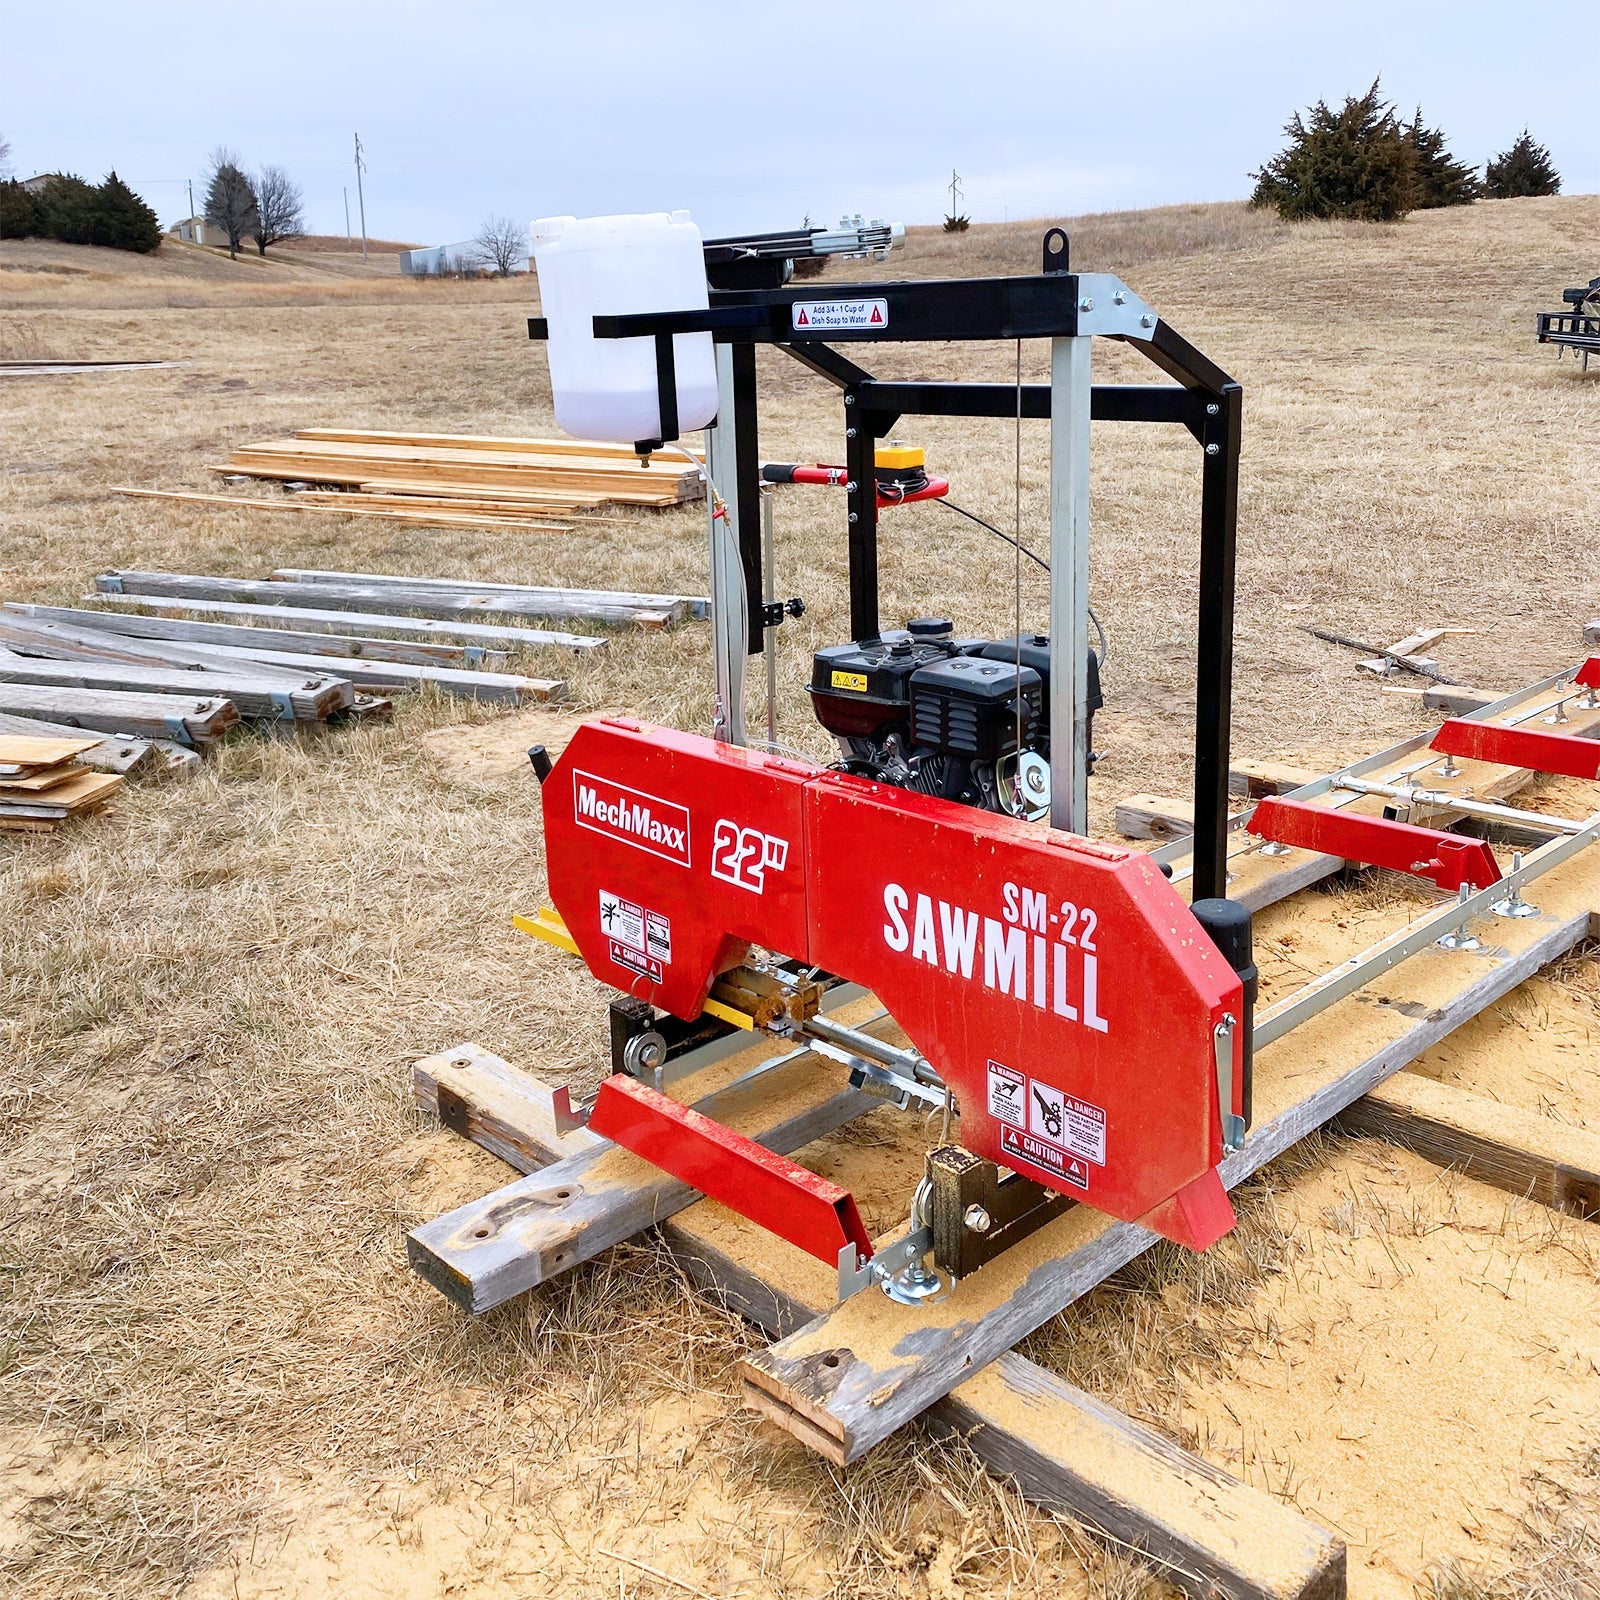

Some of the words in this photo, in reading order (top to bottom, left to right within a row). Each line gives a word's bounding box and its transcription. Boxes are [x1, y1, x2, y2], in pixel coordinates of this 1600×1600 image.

[811, 316, 825, 325] Dish
[825, 316, 841, 325] Soap
[849, 315, 867, 324] Water
[813, 306, 825, 314] Add
[826, 305, 835, 313] 3/4
[844, 304, 857, 314] Cup
[858, 304, 865, 312] of
[578, 784, 686, 852] MechMaxx
[711, 818, 789, 896] 22"
[1002, 881, 1098, 952] SM-22
[883, 883, 1109, 1034] SAWMILL
[997, 1066, 1023, 1084] WARNING
[1004, 1100, 1022, 1111] HAZARD
[1074, 1101, 1103, 1122] DANGER
[1023, 1137, 1064, 1166] CAUTION
